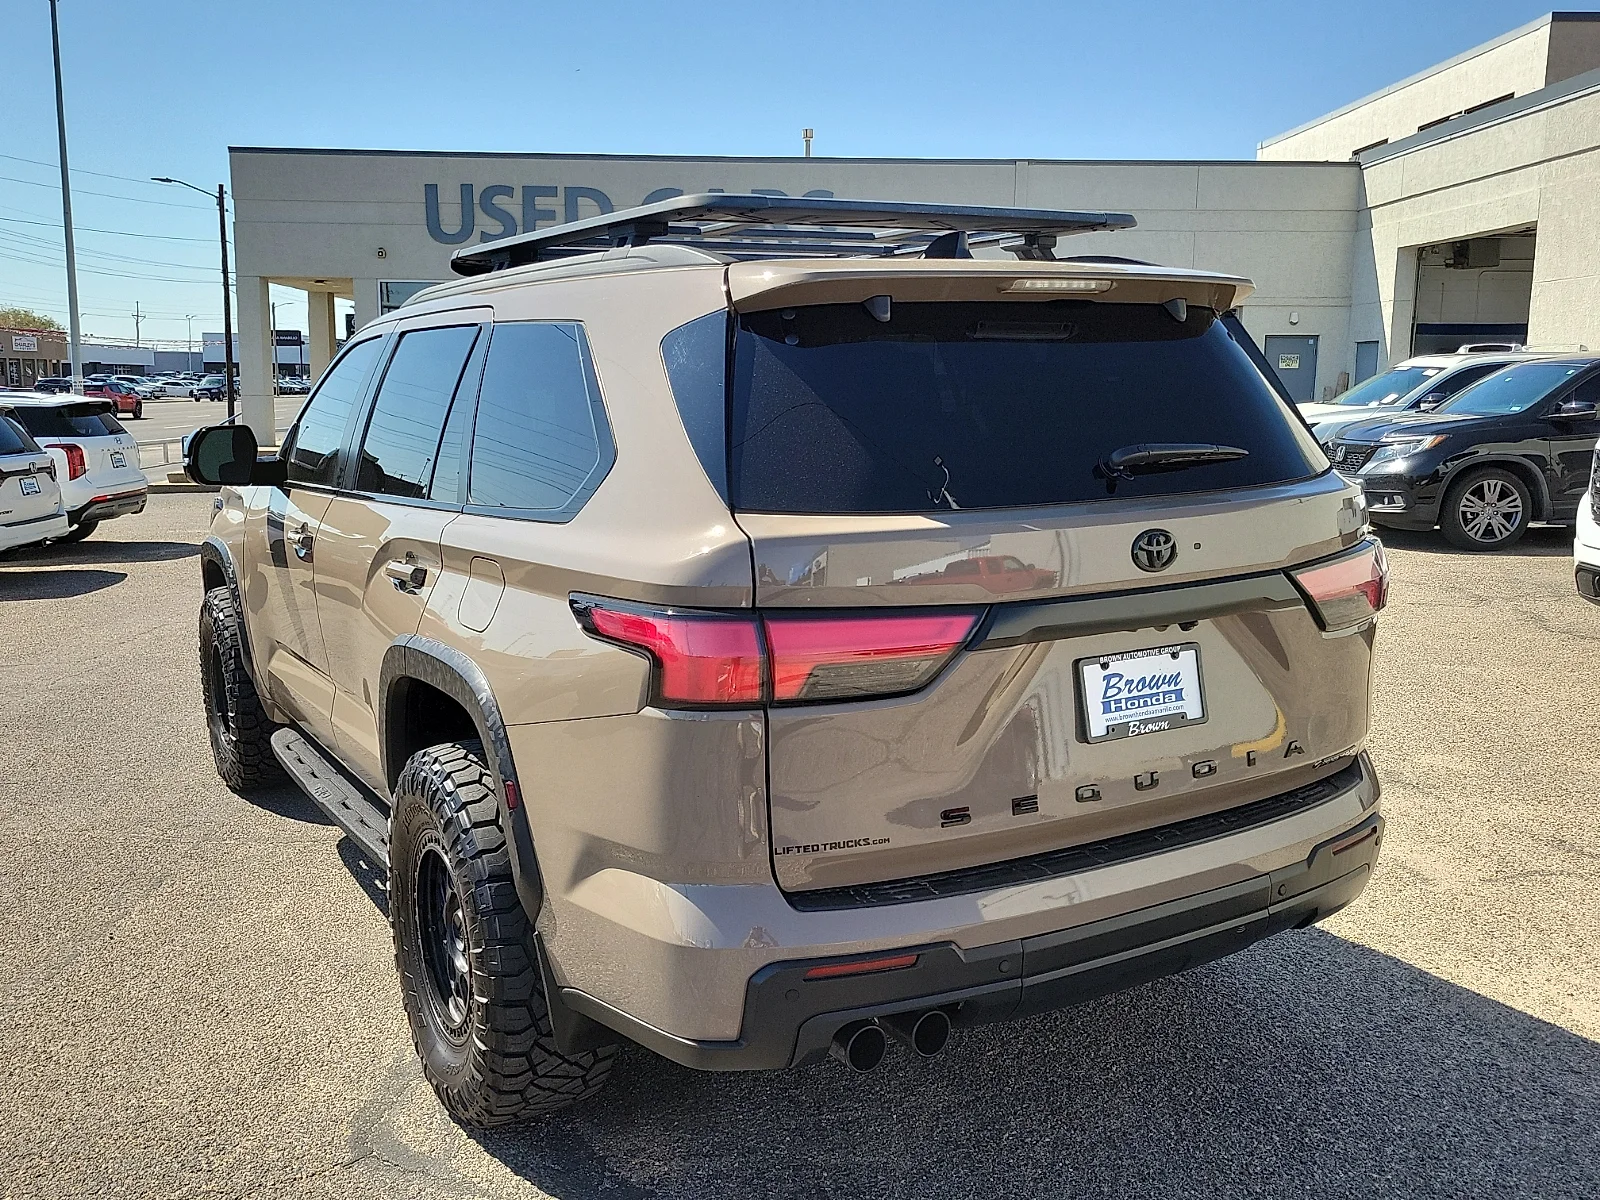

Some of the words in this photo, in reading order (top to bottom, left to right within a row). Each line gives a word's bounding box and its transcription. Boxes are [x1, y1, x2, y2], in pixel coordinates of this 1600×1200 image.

[1099, 654, 1121, 663] BROWN
[1122, 648, 1160, 661] AUTOMOTIVE
[1160, 646, 1181, 655] GROUP
[1102, 671, 1182, 700] Brown
[1110, 692, 1176, 712] Honda
[1128, 720, 1170, 736] Brown
[940, 740, 1305, 829] SEQUOIA
